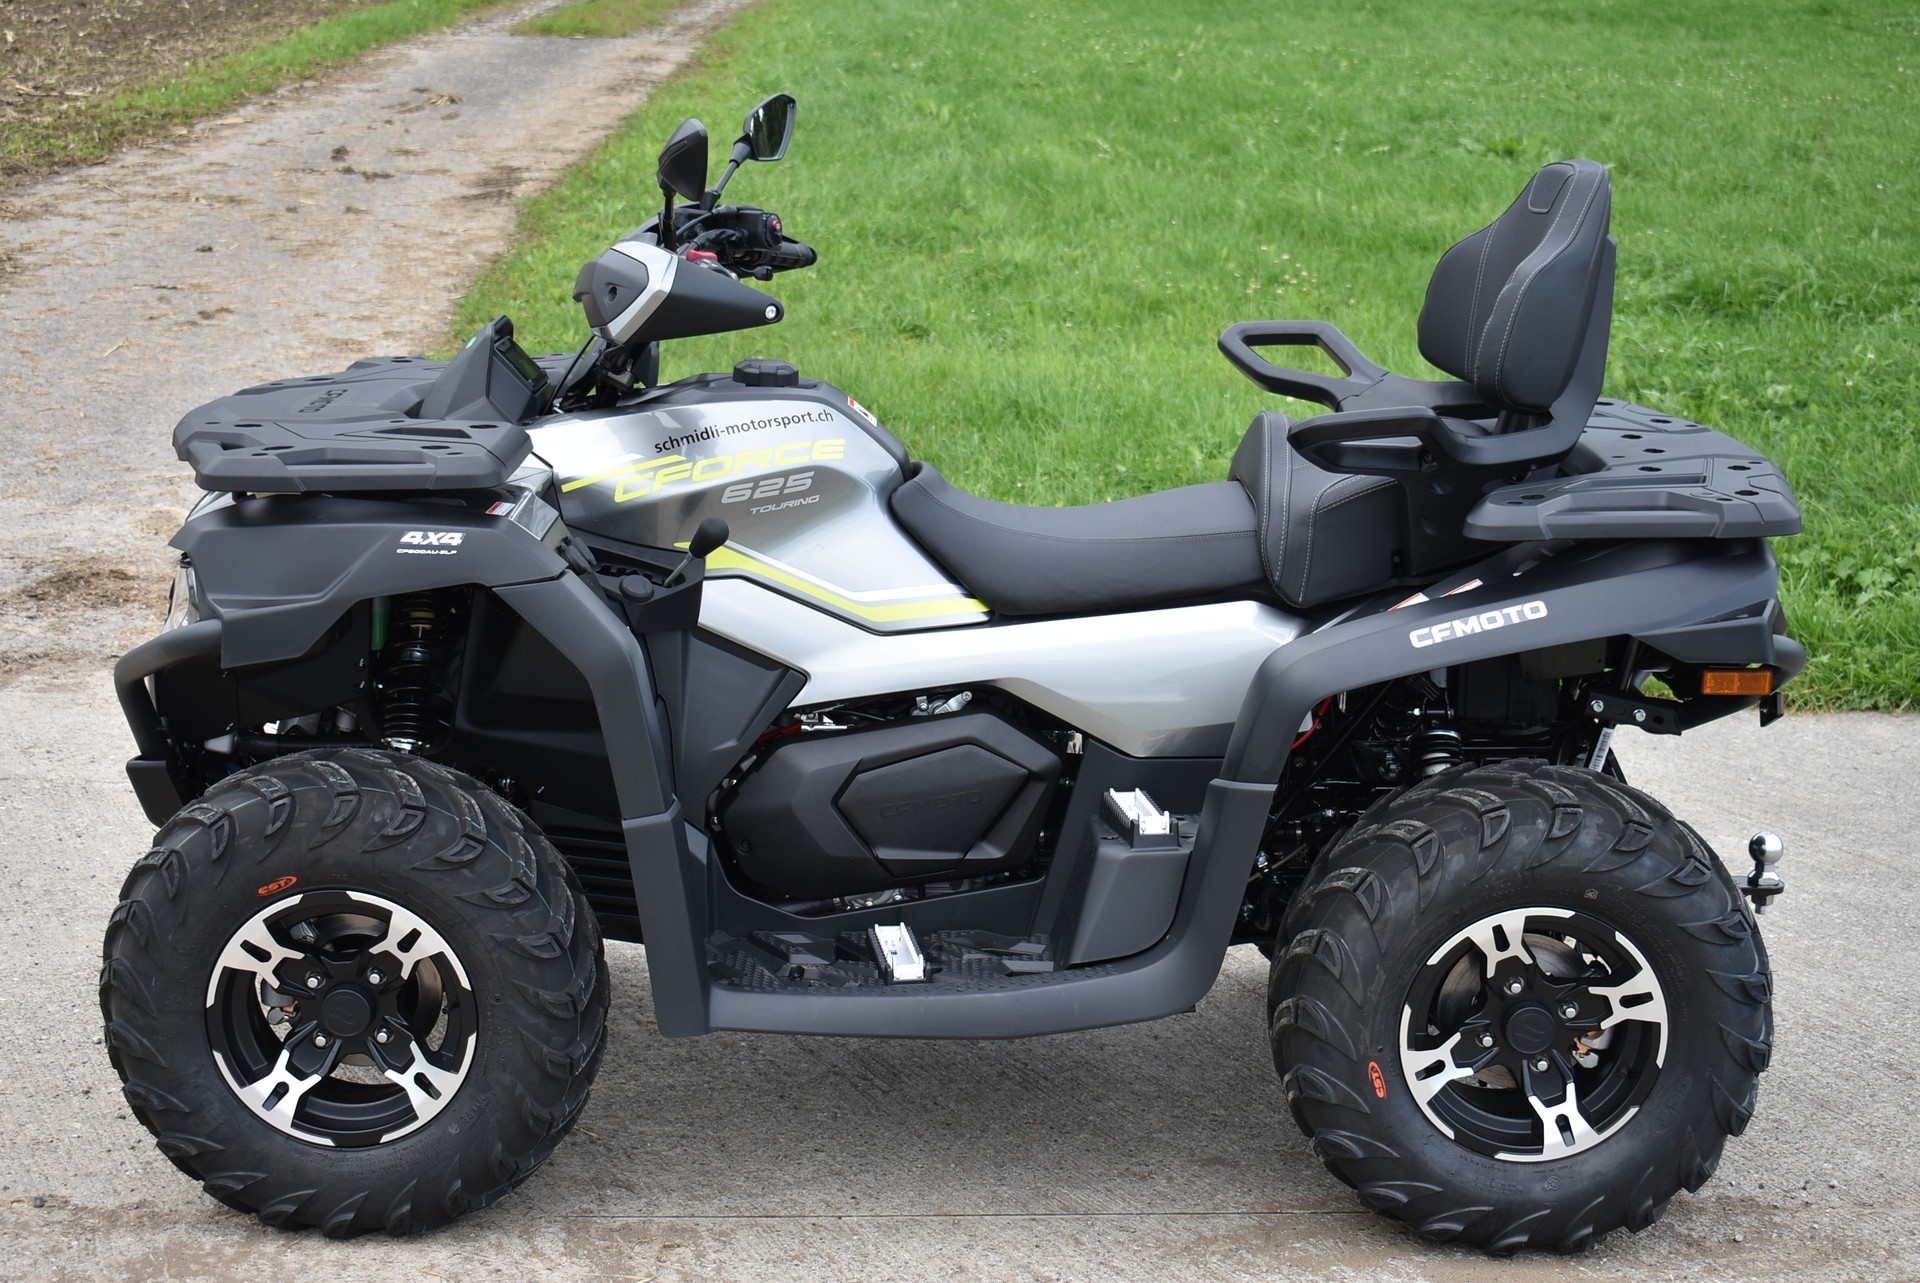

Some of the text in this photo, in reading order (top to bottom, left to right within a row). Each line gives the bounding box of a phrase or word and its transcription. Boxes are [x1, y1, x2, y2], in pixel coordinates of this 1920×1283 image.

[654, 408, 834, 454] schmidli-motorsport.ch
[614, 438, 845, 503] CFORCE
[721, 471, 815, 504] 625
[750, 494, 820, 515] TOURING
[1409, 600, 1548, 649] CFMOTO
[880, 789, 984, 819] CFMOTO
